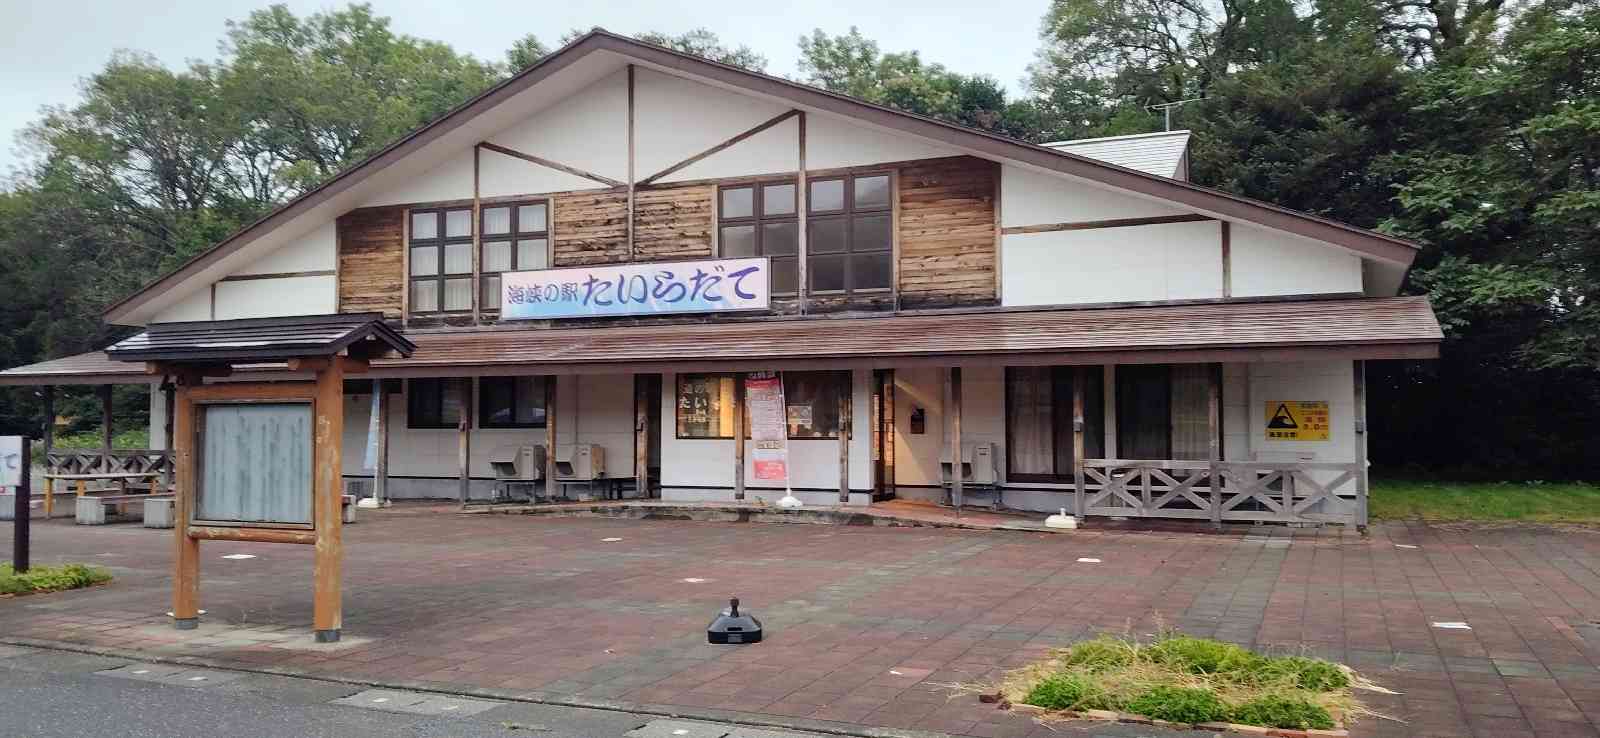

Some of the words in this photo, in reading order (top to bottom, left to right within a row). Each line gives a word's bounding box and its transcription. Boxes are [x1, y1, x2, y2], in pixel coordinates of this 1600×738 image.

[508, 282, 578, 305] 海峡の駅
[583, 266, 760, 306] たいらだて
